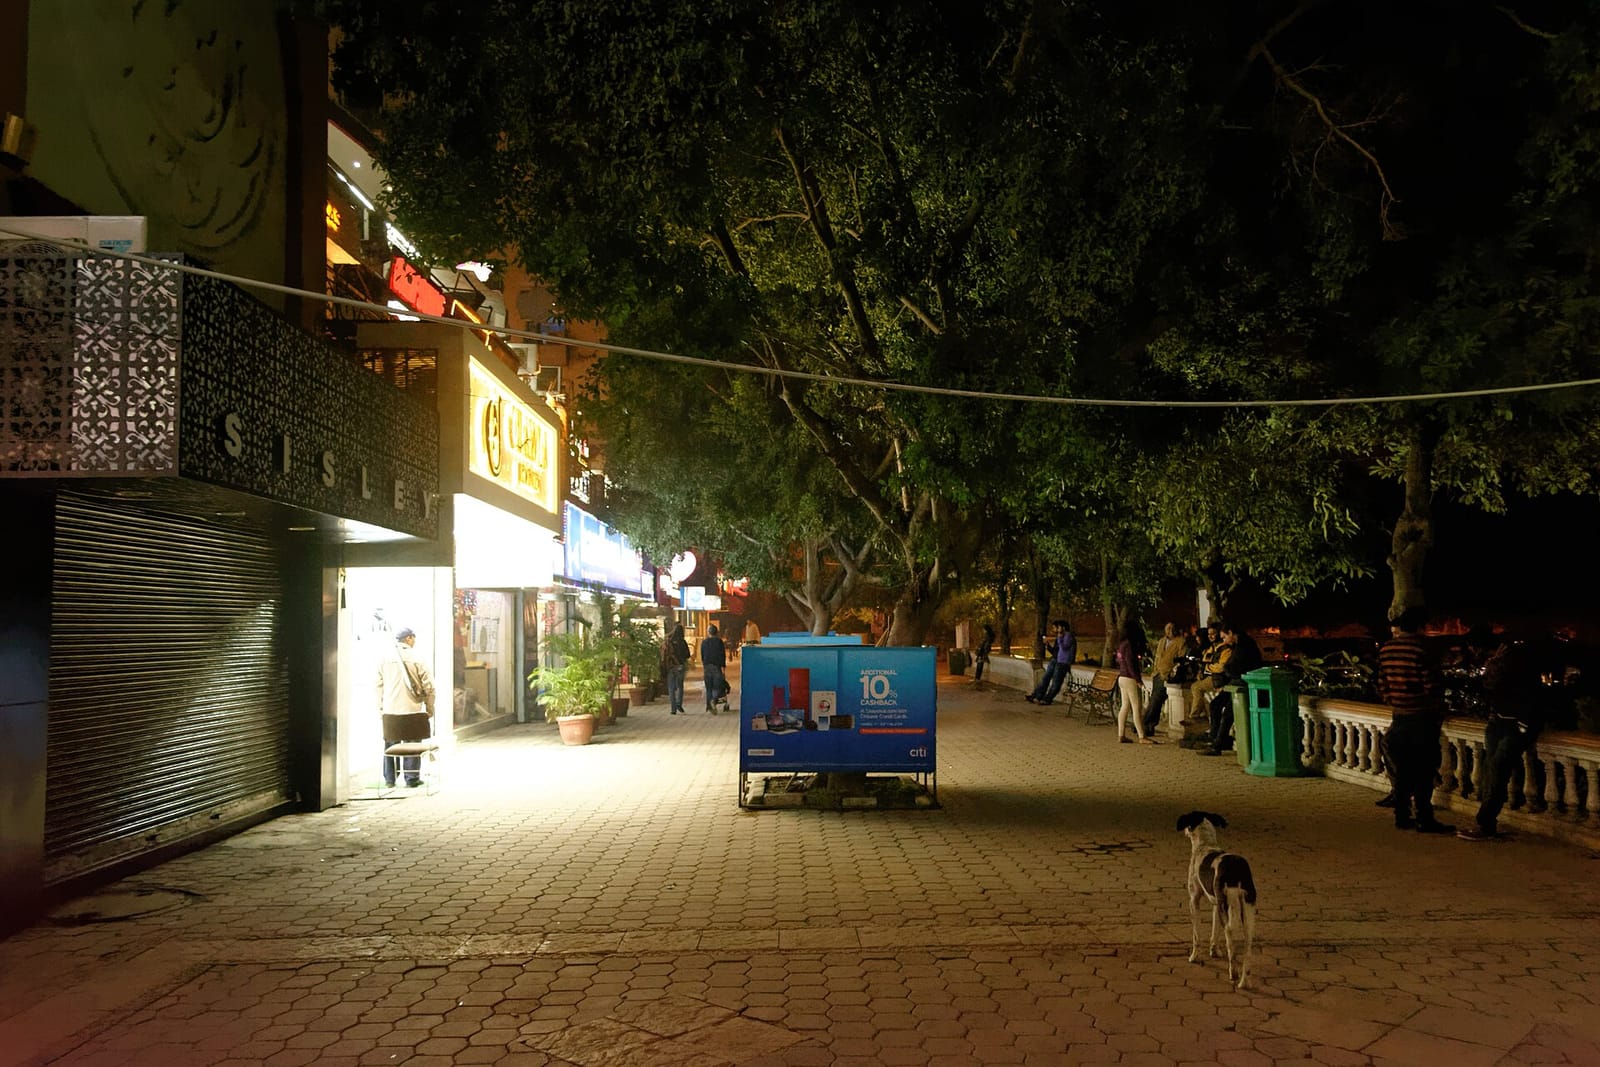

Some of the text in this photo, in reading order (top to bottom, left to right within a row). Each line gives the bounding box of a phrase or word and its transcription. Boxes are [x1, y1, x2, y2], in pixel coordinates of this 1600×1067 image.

[224, 412, 432, 519] SISLEY
[860, 675, 898, 699] 10%
[909, 746, 927, 758] citi
